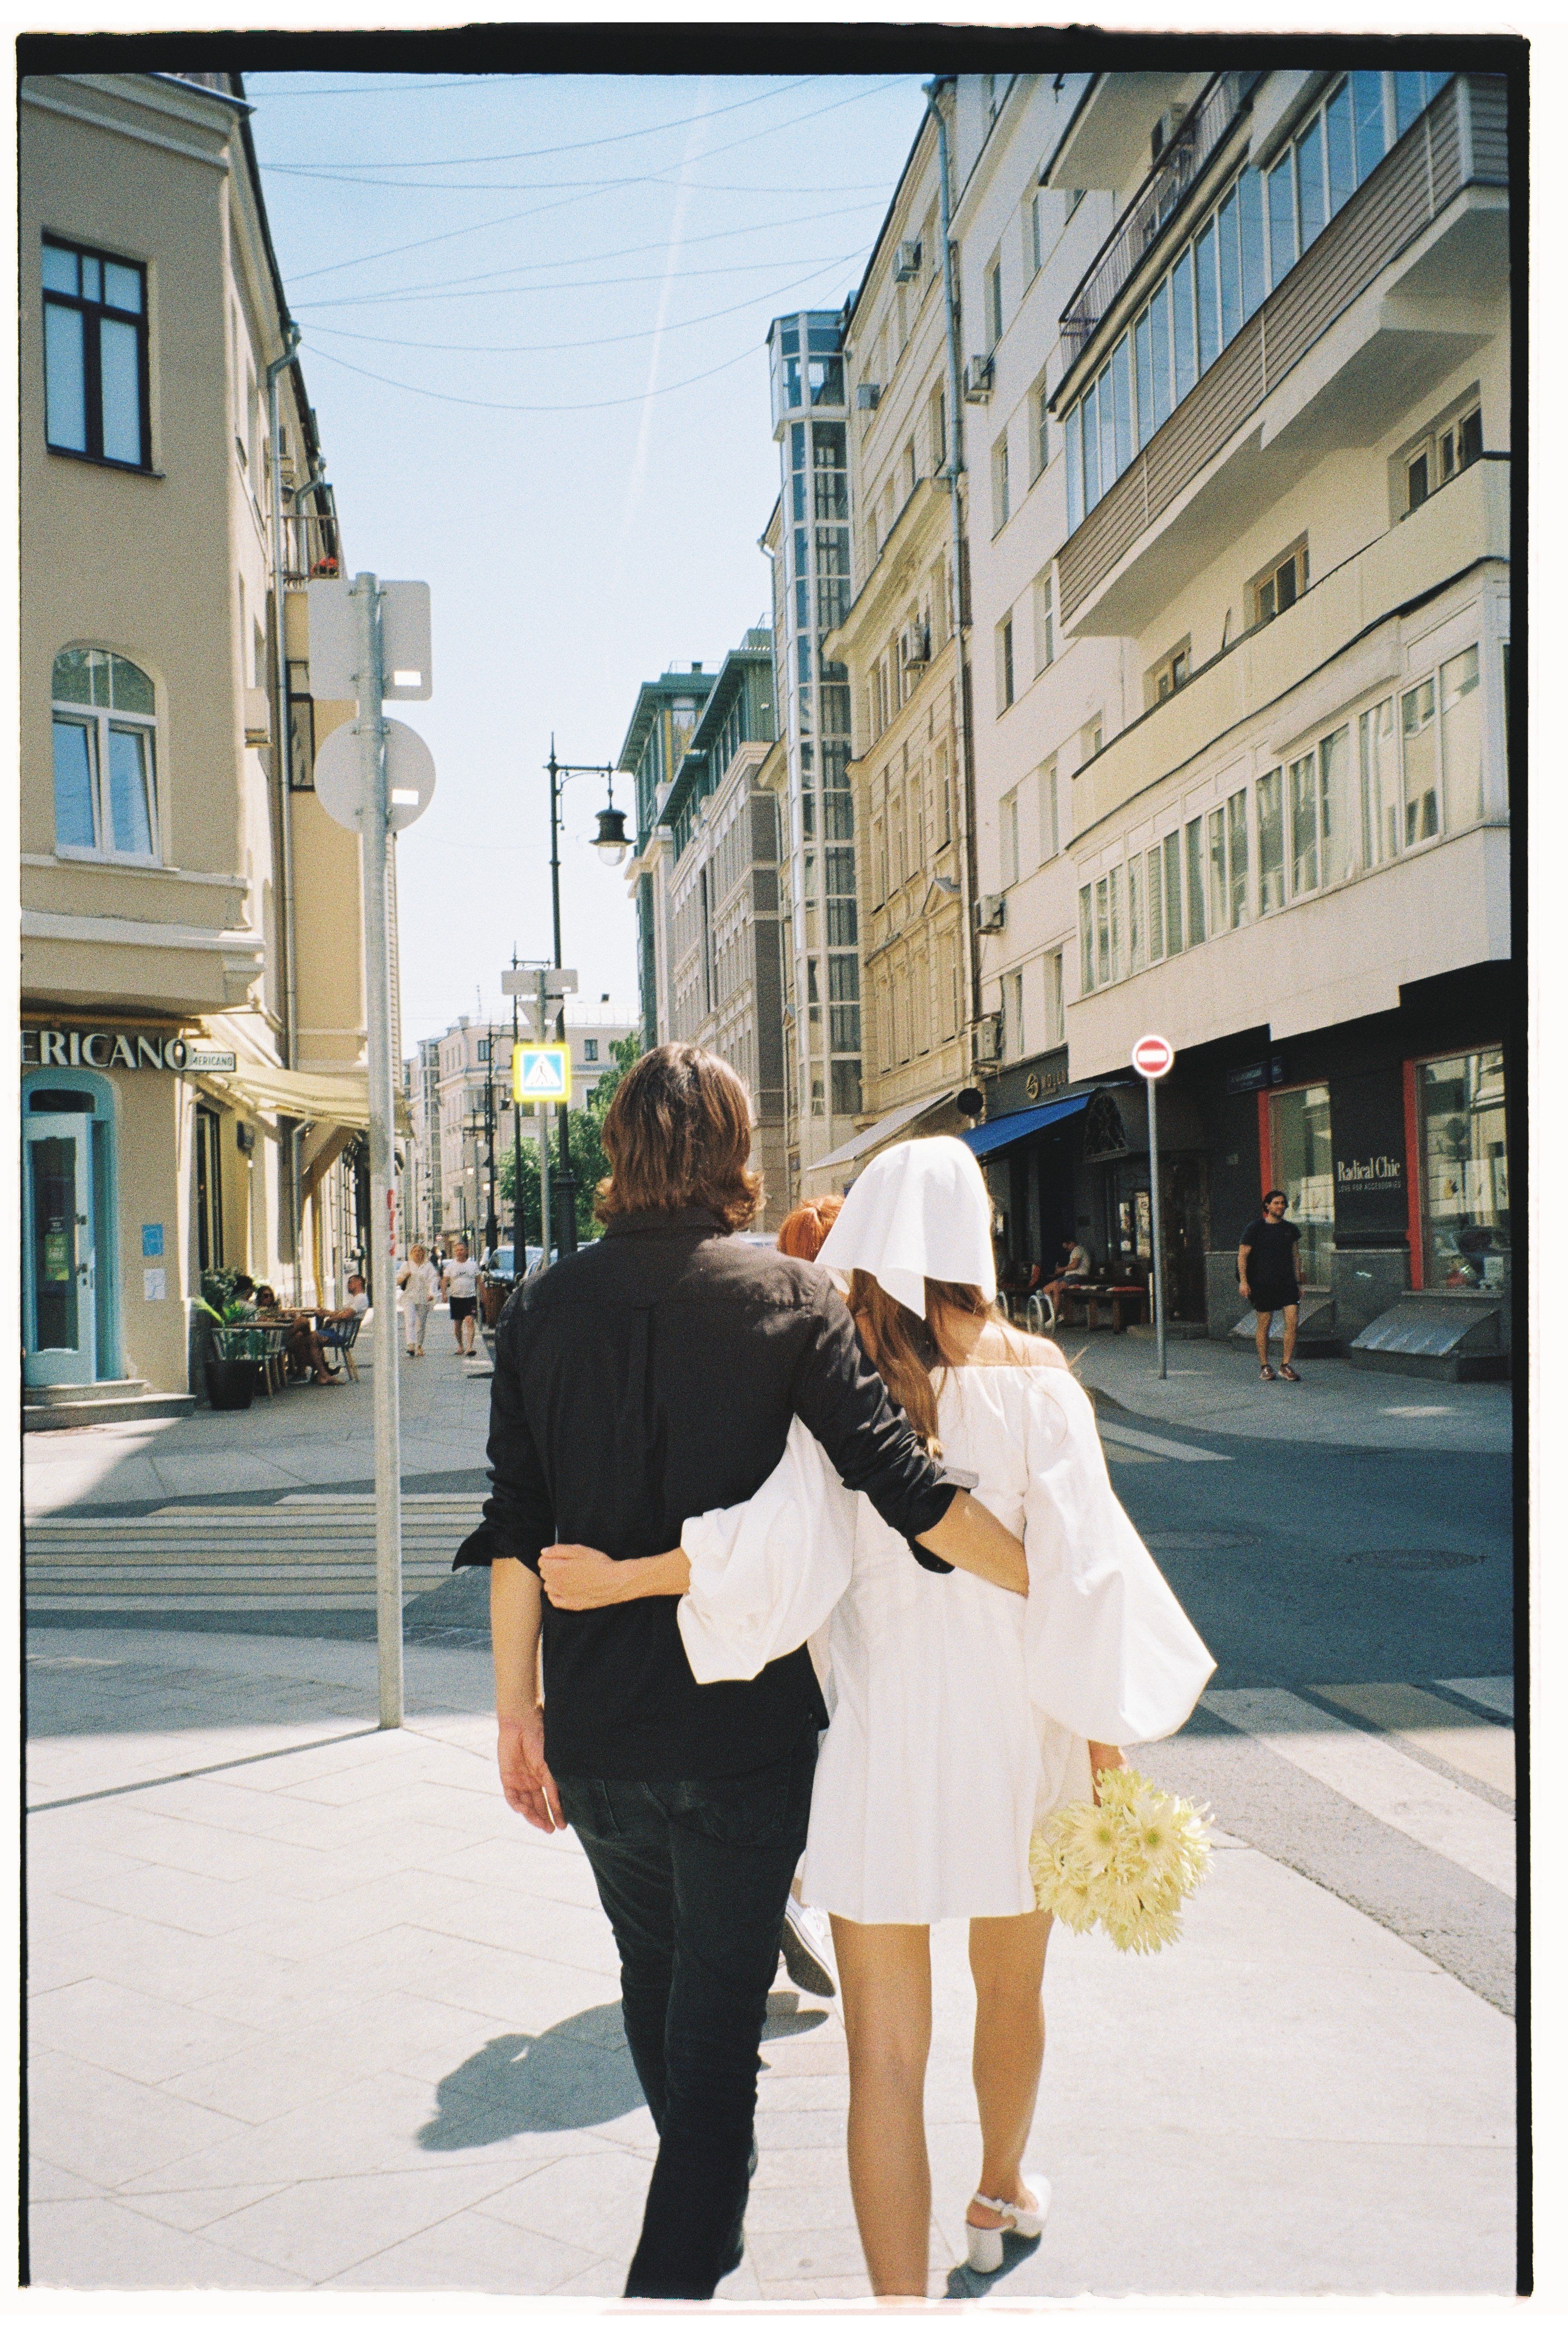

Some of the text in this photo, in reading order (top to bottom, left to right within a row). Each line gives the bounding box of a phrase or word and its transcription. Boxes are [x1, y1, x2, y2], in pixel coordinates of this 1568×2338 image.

[21, 1030, 193, 1070] ERICANO
[1337, 1156, 1401, 1181] Radical Chic
